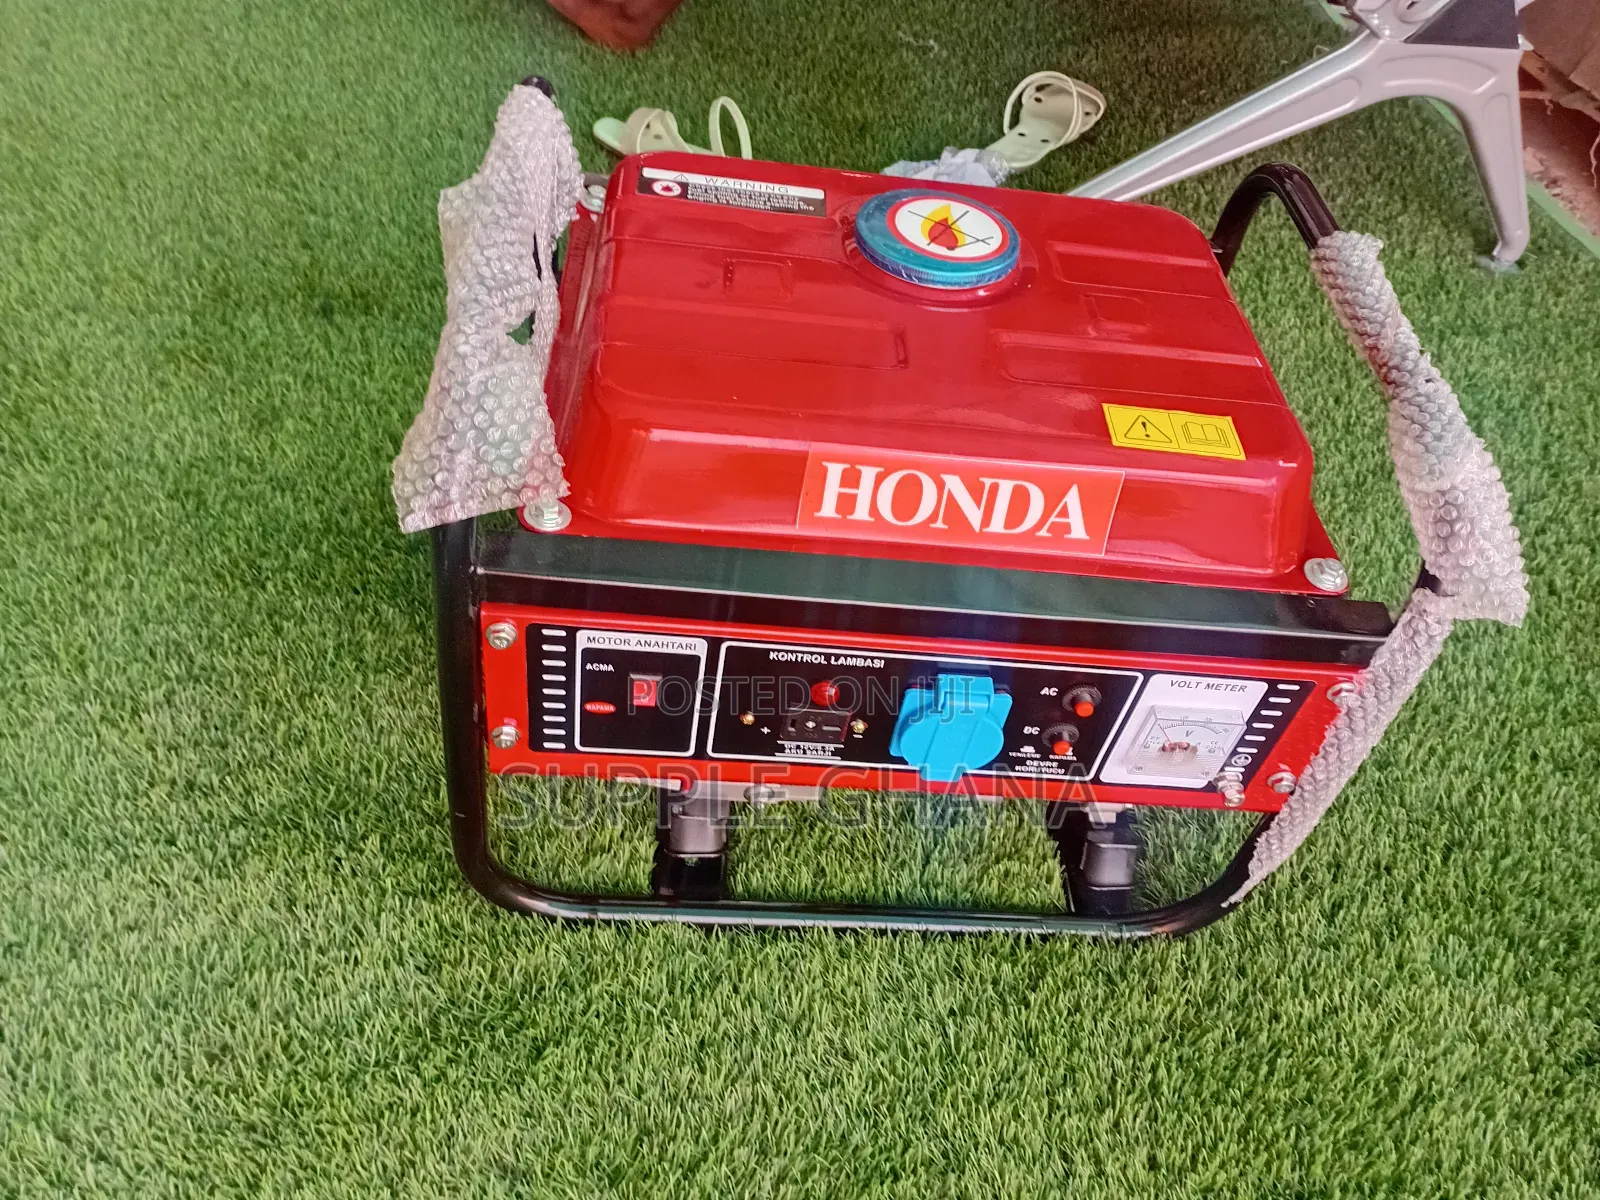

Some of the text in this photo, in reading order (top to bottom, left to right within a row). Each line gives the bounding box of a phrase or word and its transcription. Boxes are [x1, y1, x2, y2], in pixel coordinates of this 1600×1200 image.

[705, 177, 788, 193] WARNING
[813, 461, 1090, 540] HONDA
[586, 636, 697, 651] MOTOR ANAHTARI
[769, 651, 885, 668] KONTROL LAMBASI
[1040, 687, 1058, 696] AC
[1170, 680, 1247, 693] VOLT METER
[1023, 726, 1040, 735] DC
